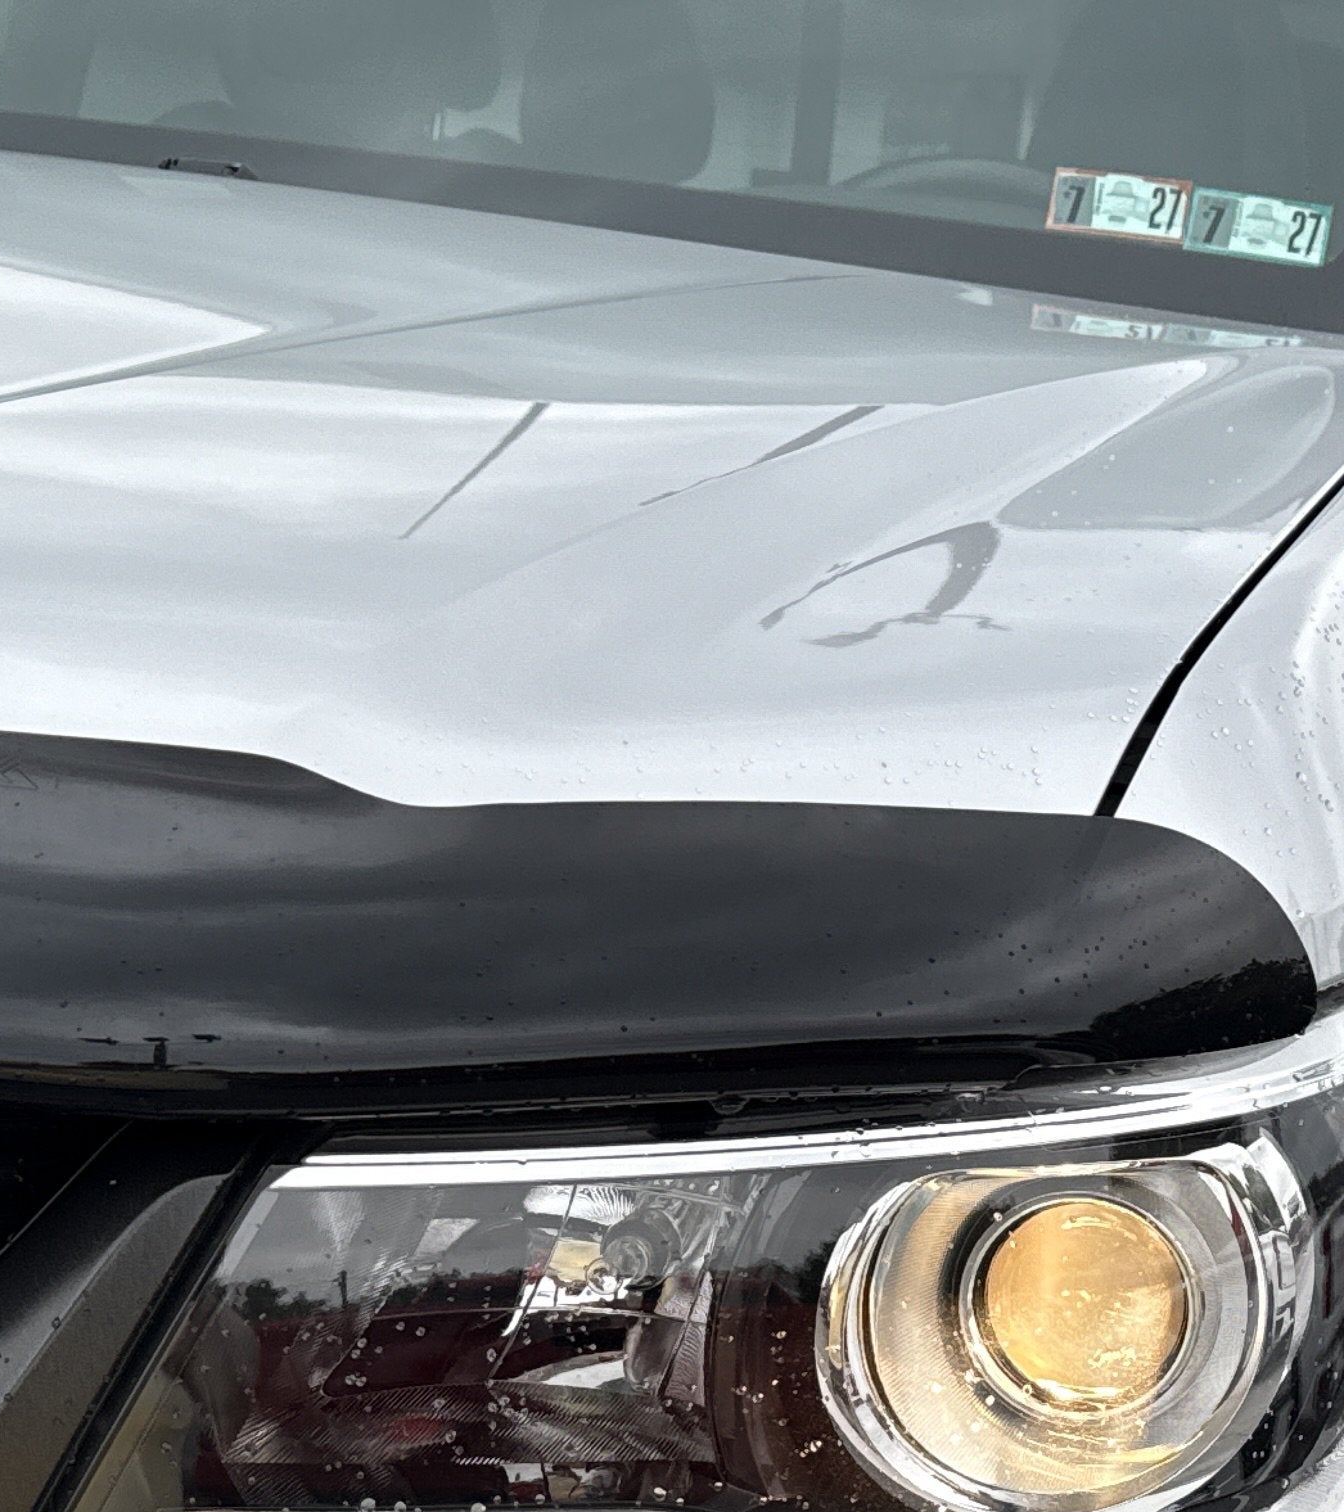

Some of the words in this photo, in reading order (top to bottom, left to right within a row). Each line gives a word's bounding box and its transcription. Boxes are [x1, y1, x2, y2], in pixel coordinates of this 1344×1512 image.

[1067, 184, 1086, 224] 7
[1147, 186, 1184, 234] 27
[1203, 204, 1226, 244] 7
[1287, 210, 1323, 257] 27
